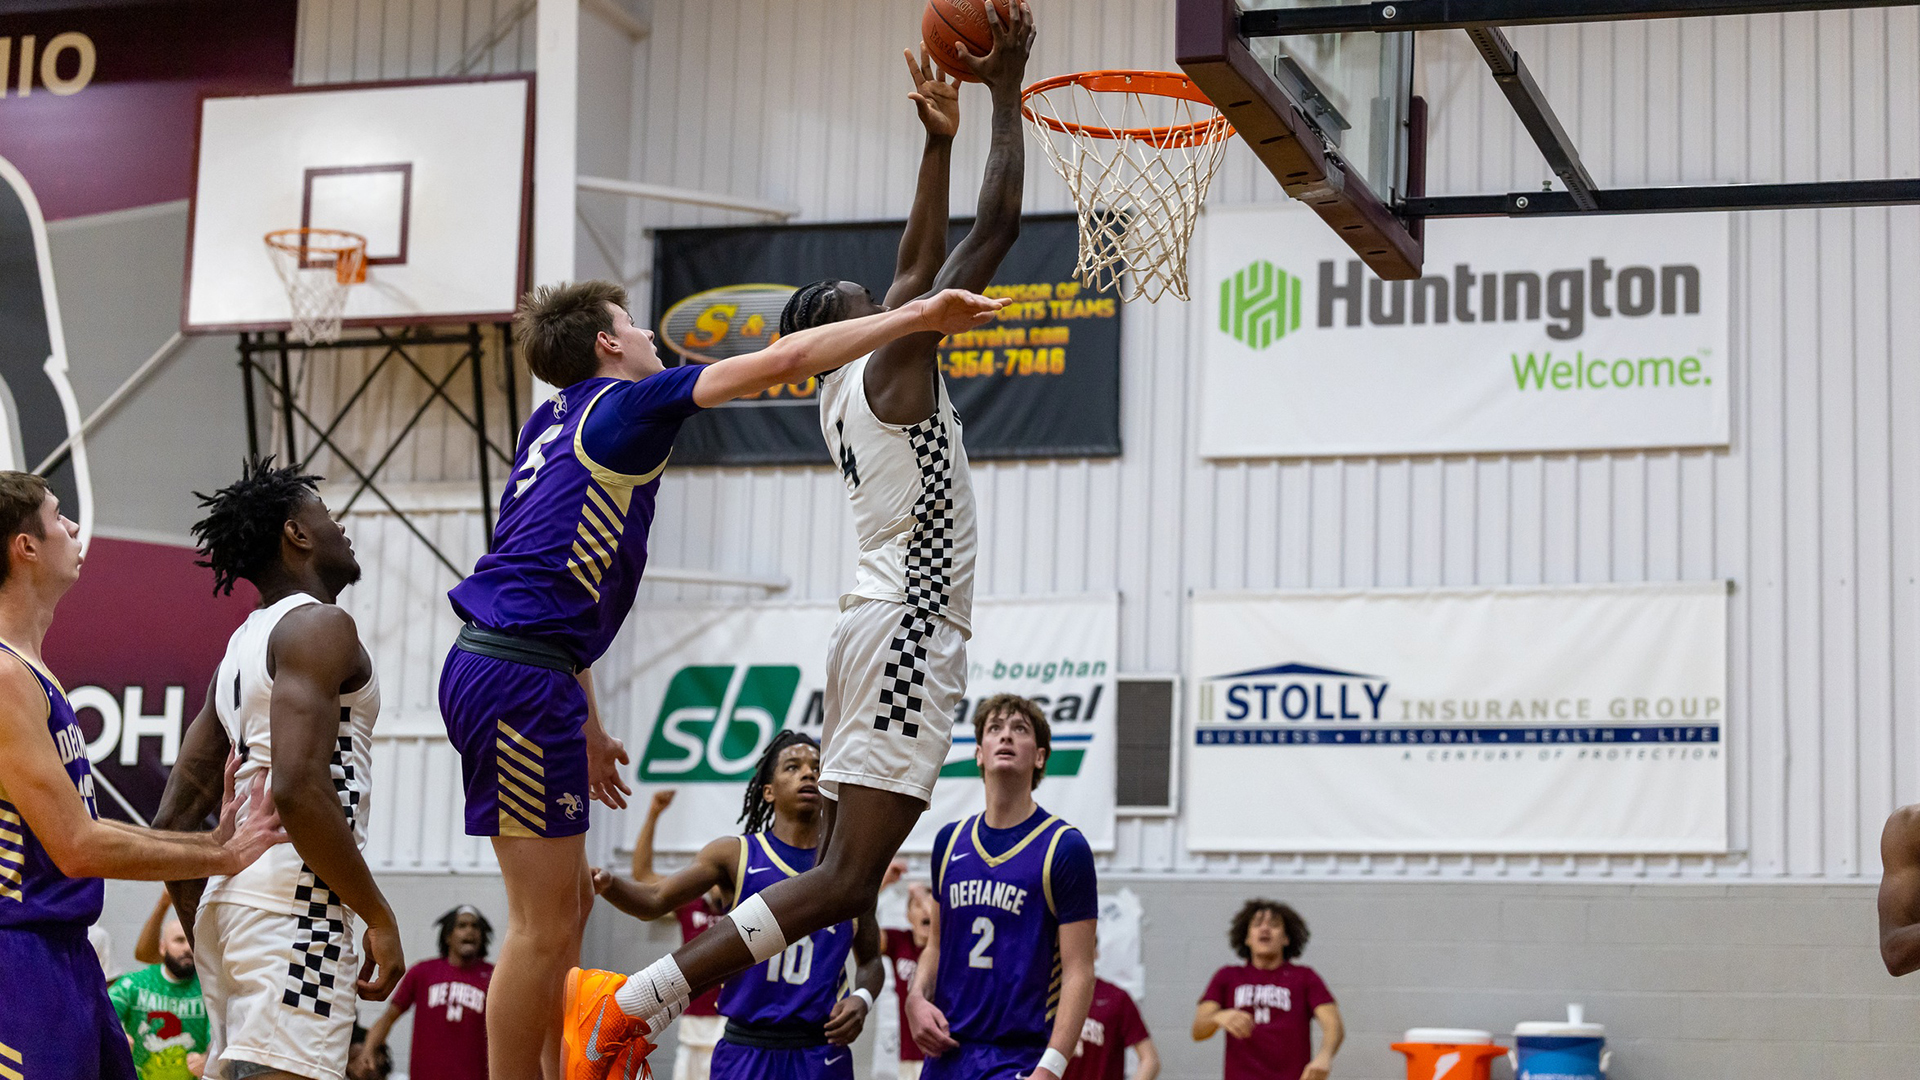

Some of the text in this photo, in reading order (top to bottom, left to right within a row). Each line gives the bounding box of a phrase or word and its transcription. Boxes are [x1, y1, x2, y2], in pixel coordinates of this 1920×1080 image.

[981, 281, 1081, 300] PONSOR OF
[993, 298, 1116, 320] ORTS TEAMS
[1317, 257, 1700, 341] Huntington
[684, 304, 737, 348] S
[1511, 351, 1712, 391] Welcome.
[513, 424, 564, 499] 5
[835, 416, 860, 488] 4
[970, 657, 1107, 683] h-boughan
[1226, 684, 1721, 721] STOLLY INSURANCE GROUP
[1202, 728, 1712, 745] BUSINESS PERSONAL HEALTH LIFE
[1401, 749, 1720, 762] A CENTURY OF PROTECTION
[950, 879, 1028, 916] DEFIANCE
[968, 916, 995, 970] 2
